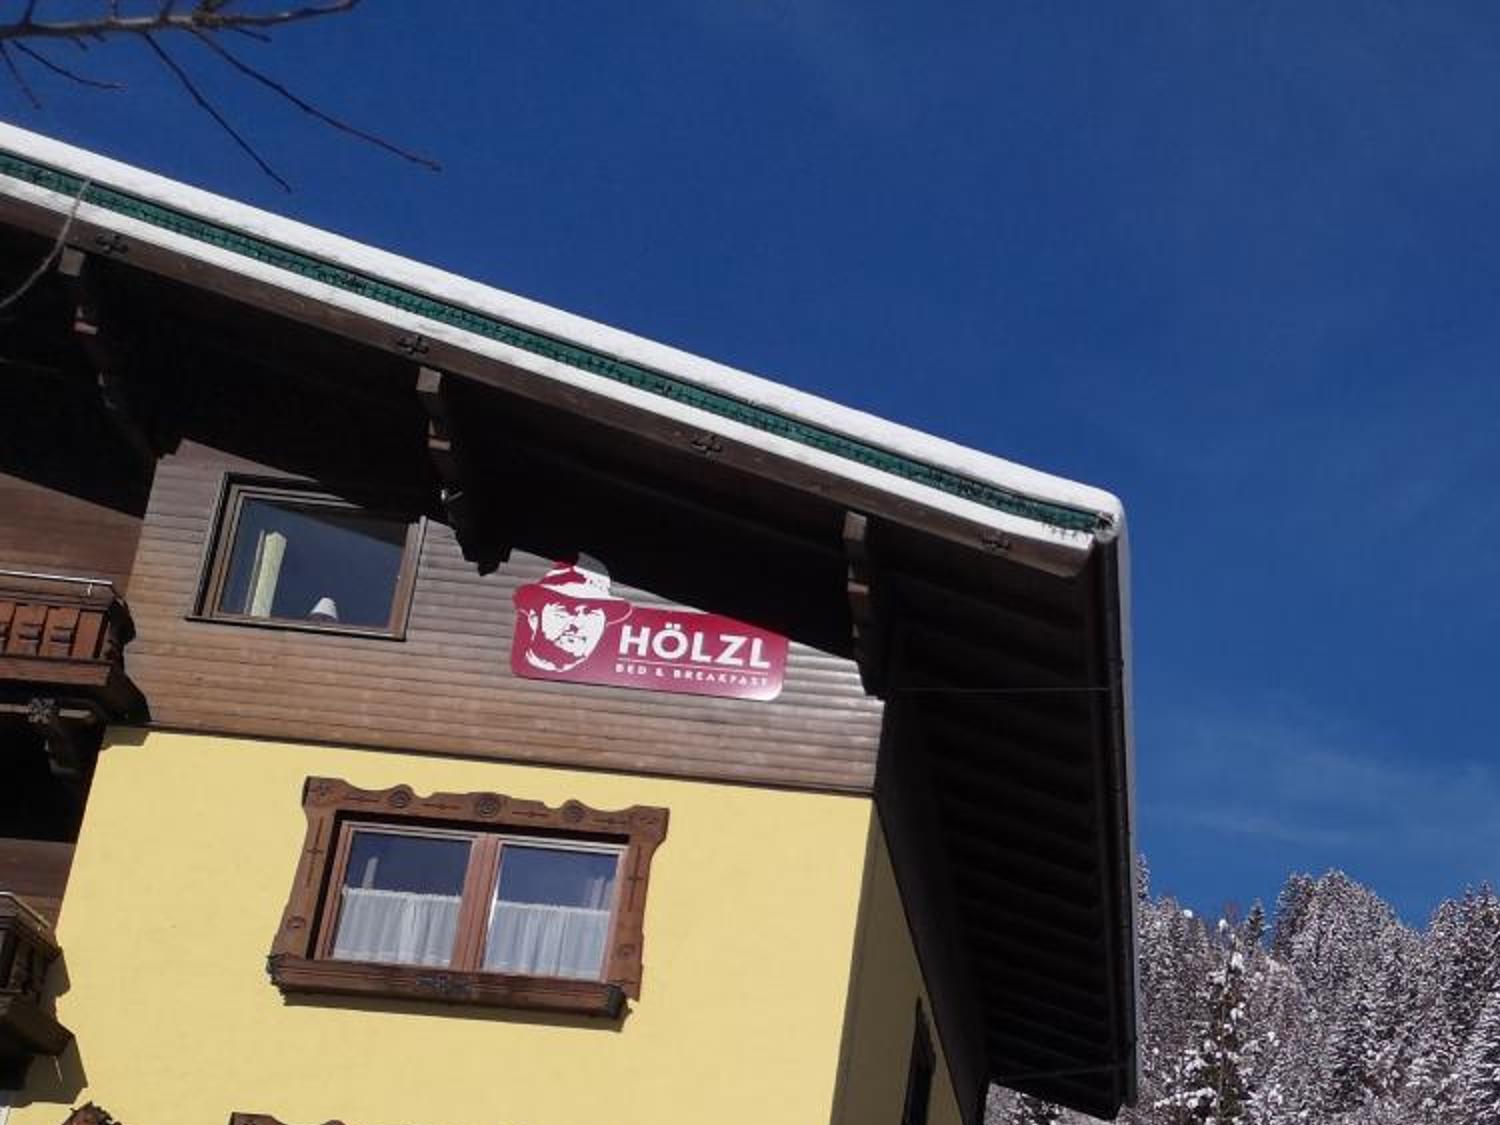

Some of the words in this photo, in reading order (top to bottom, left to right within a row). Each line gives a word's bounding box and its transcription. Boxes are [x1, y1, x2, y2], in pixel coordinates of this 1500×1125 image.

[618, 622, 771, 669] HÖLZL
[615, 663, 647, 675] BED
[655, 667, 664, 677] &
[673, 669, 768, 686] BREAKFAST
